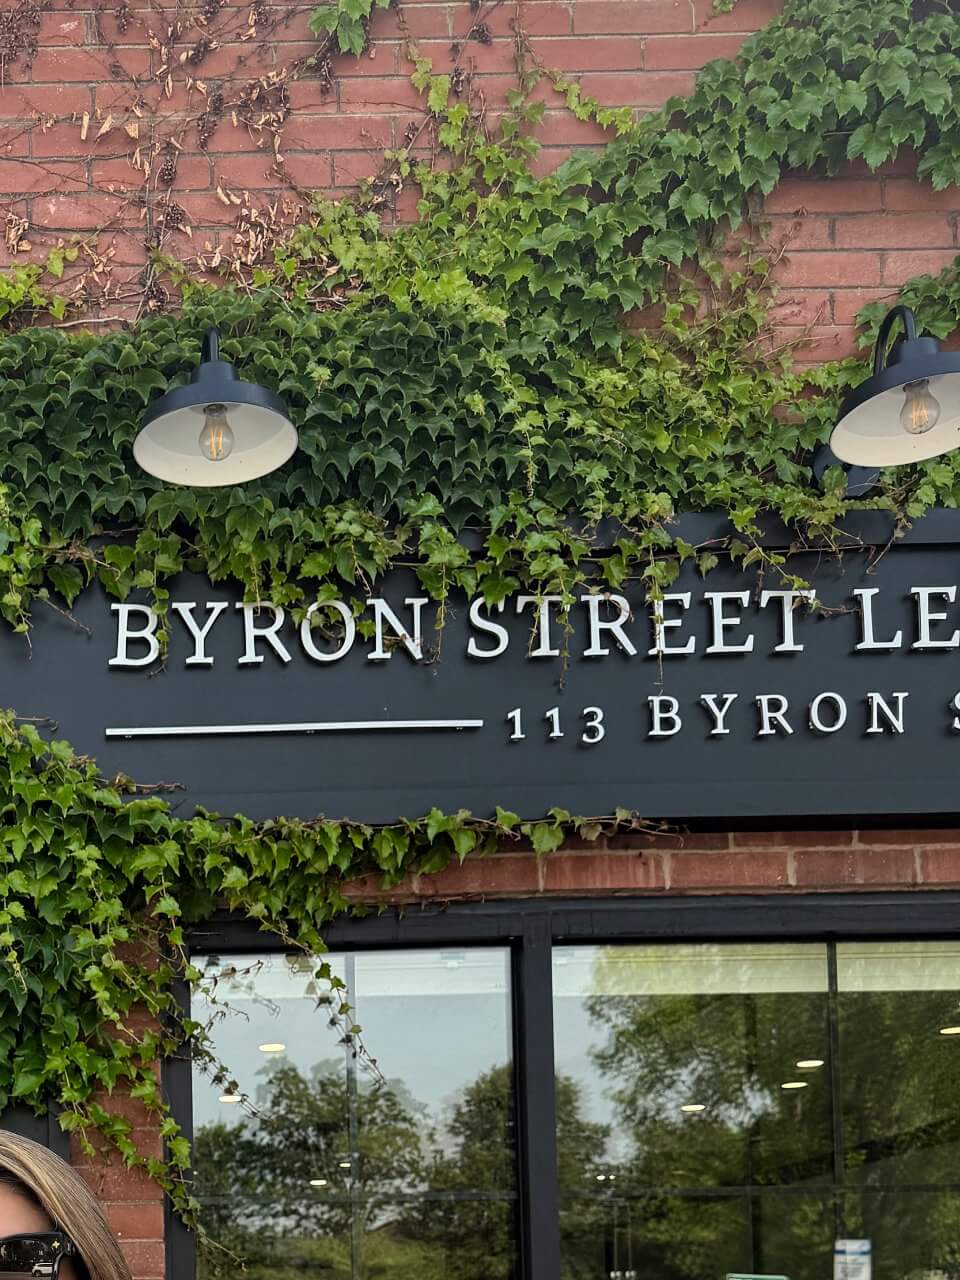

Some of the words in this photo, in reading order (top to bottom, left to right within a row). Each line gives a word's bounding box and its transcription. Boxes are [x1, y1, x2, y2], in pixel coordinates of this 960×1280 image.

[107, 597, 429, 666] BYRON
[467, 588, 817, 658] STREET
[852, 585, 960, 651] LE
[506, 706, 606, 743] 113
[647, 691, 909, 736] BYRON
